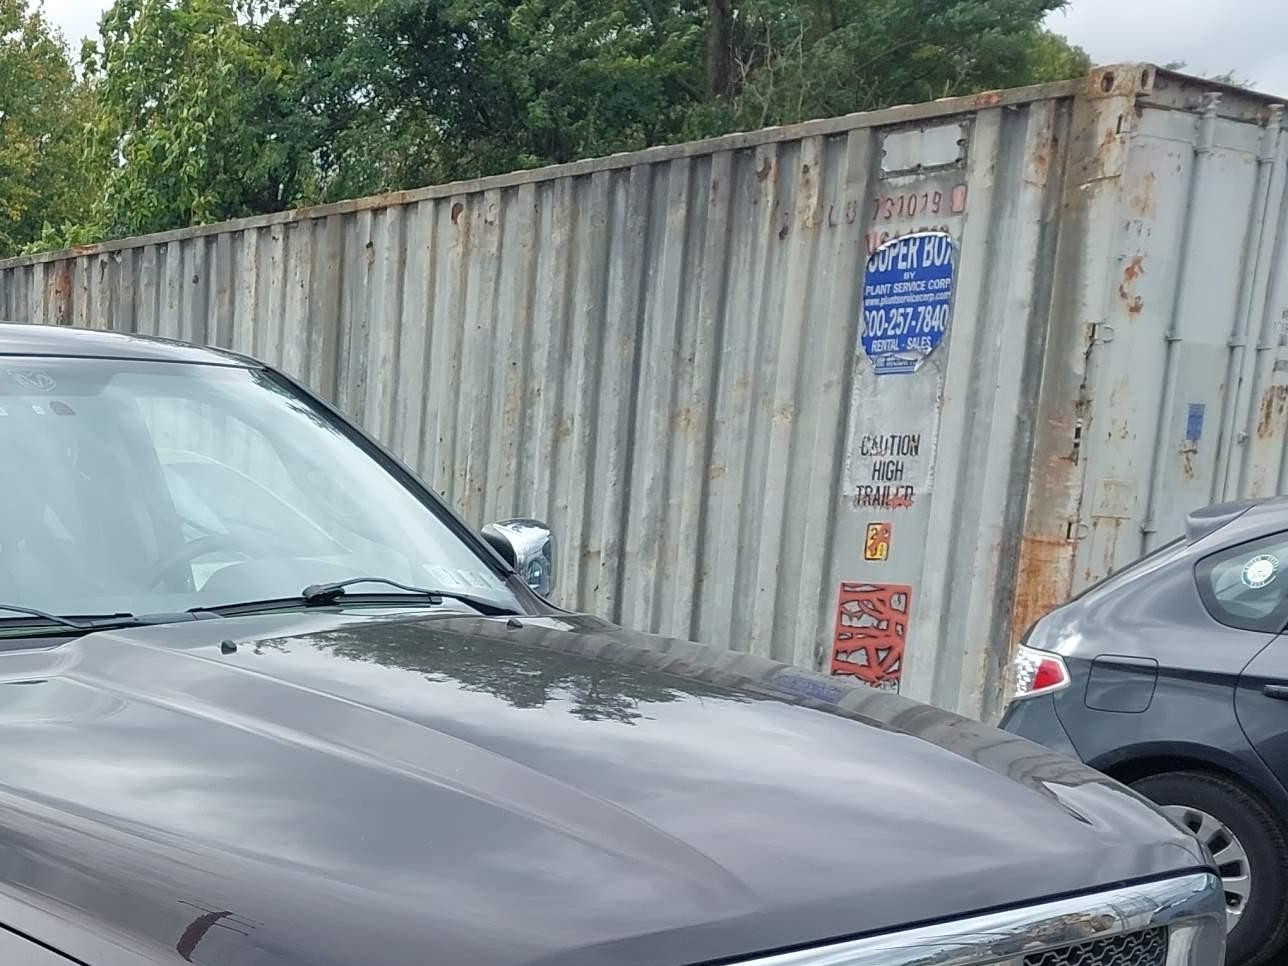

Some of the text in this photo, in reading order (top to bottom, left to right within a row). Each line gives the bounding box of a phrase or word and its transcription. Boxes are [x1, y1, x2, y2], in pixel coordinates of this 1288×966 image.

[903, 271, 916, 280] BY
[865, 278, 952, 297] PLANT SERVICE CORP
[872, 339, 900, 352] RENTAL
[906, 336, 932, 350] SALES
[860, 433, 920, 457] CAUTION
[871, 460, 904, 481] HIGH
[856, 484, 914, 507] TRAILER
